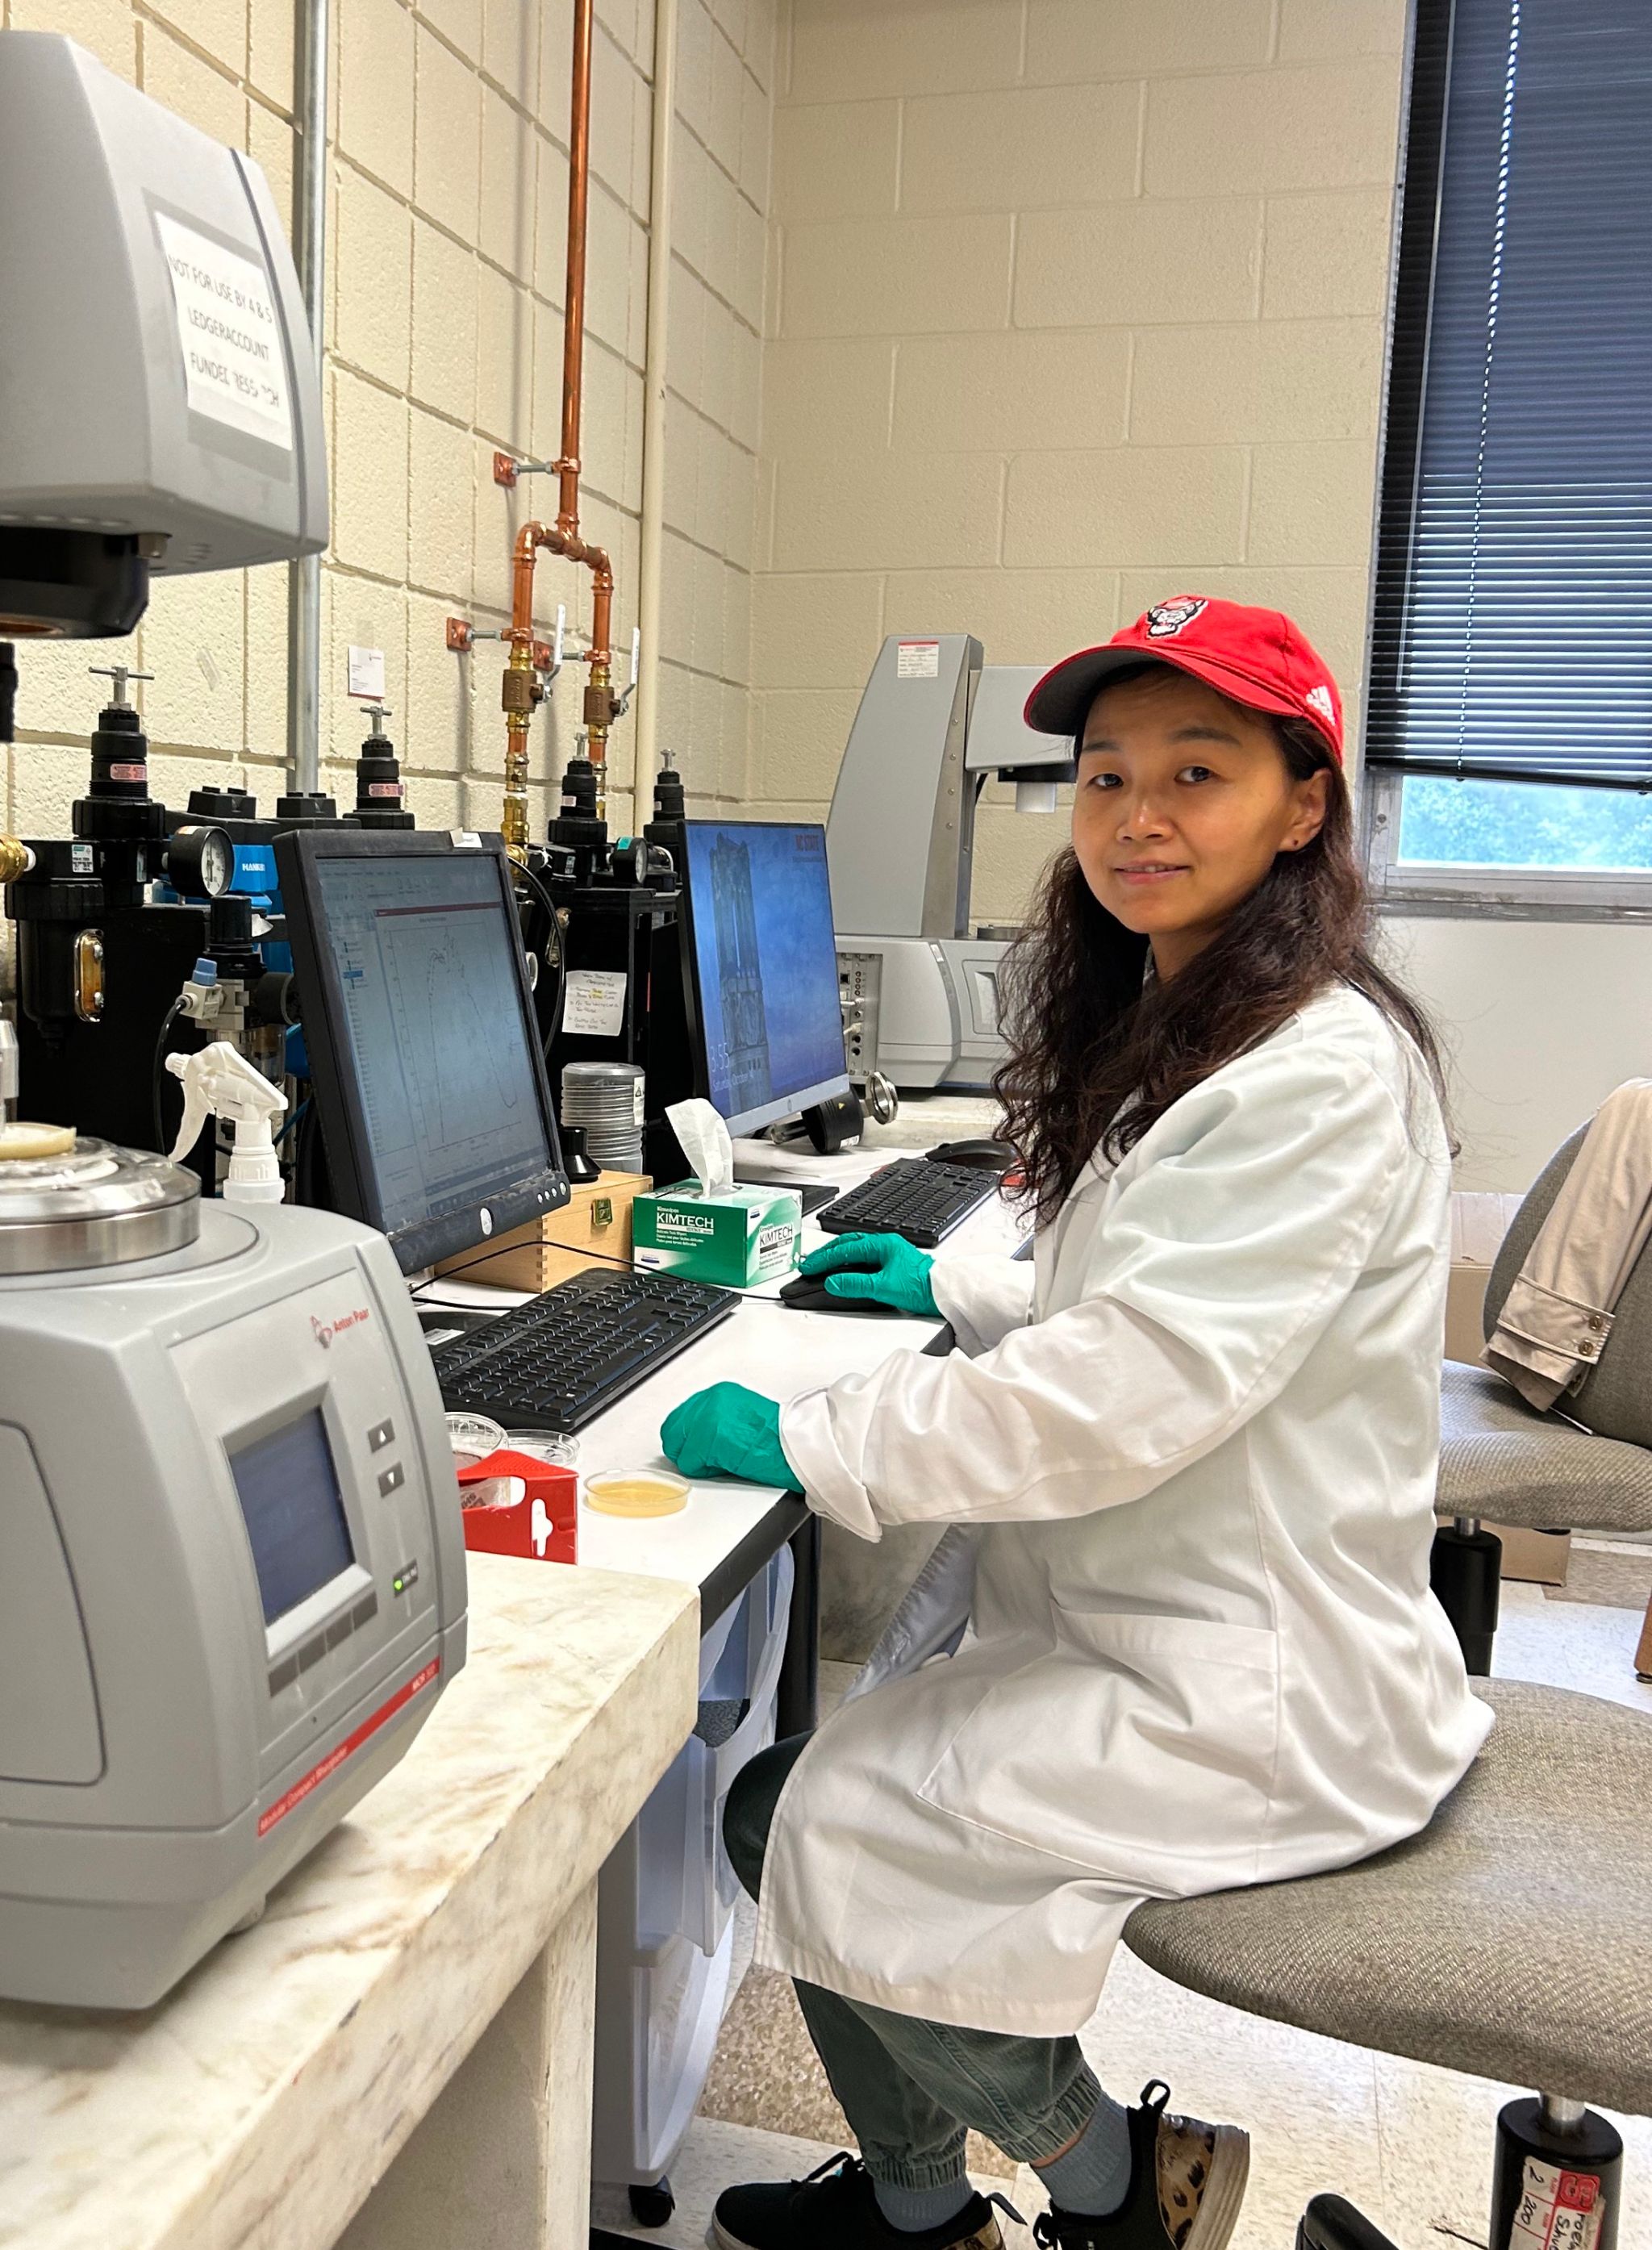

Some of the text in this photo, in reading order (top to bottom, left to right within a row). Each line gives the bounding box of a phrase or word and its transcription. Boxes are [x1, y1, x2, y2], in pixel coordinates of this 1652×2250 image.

[168, 255, 190, 280] NOT
[192, 267, 212, 292] FOR
[213, 278, 233, 303] USE
[234, 290, 245, 309] BY
[657, 1212, 714, 1229] KIMTECH
[760, 1225, 792, 1247] KIMTECH
[334, 1317, 354, 1333] Anton
[1529, 2165, 1544, 2184] 2
[1521, 2195, 1537, 2226] 200
